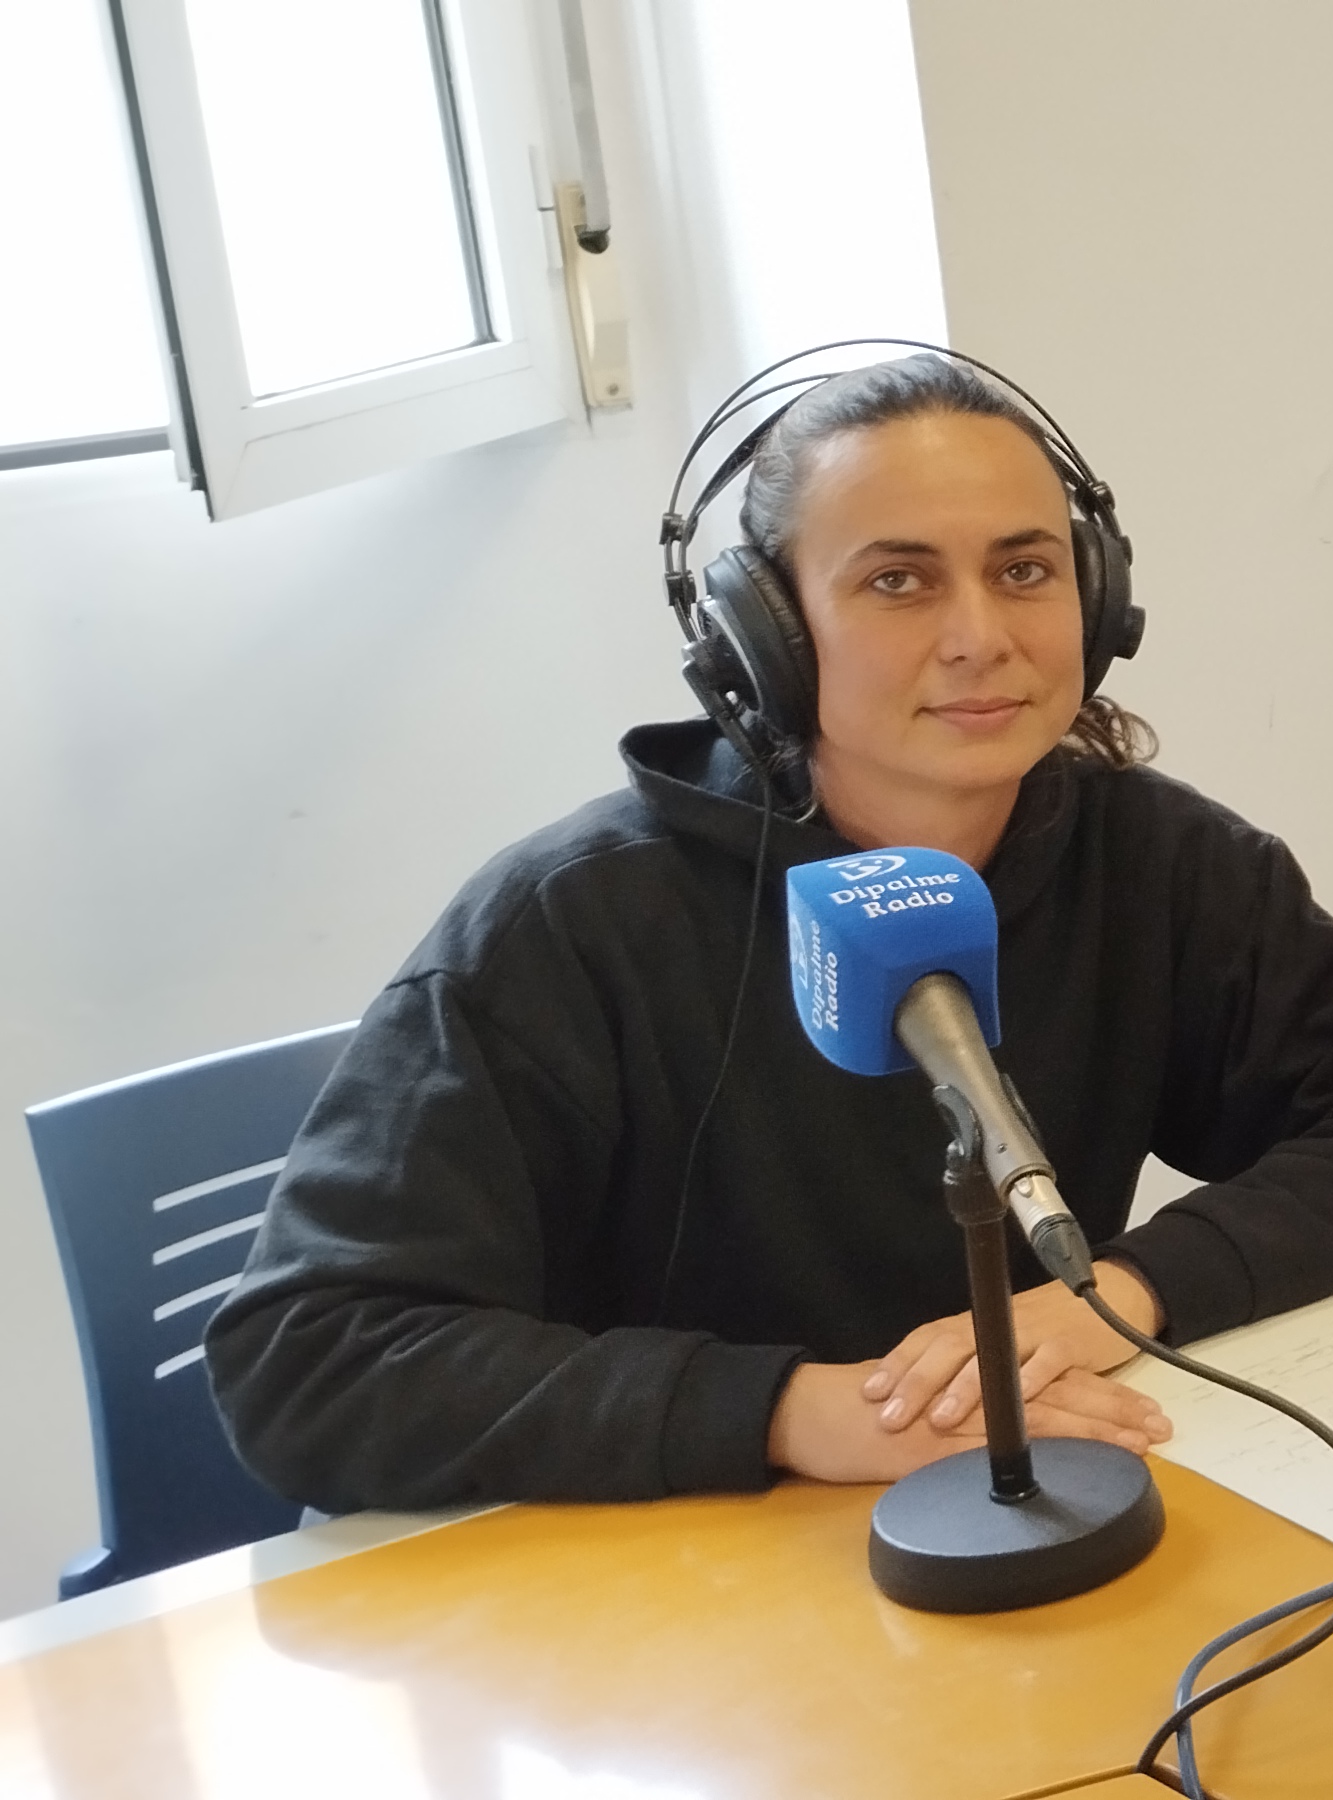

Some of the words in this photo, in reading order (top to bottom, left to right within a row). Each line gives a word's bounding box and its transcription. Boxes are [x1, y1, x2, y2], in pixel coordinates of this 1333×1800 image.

[828, 871, 961, 905] Dipalme
[861, 890, 955, 919] Radio
[811, 919, 822, 1030] Dipalme
[824, 950, 839, 1032] Radio
